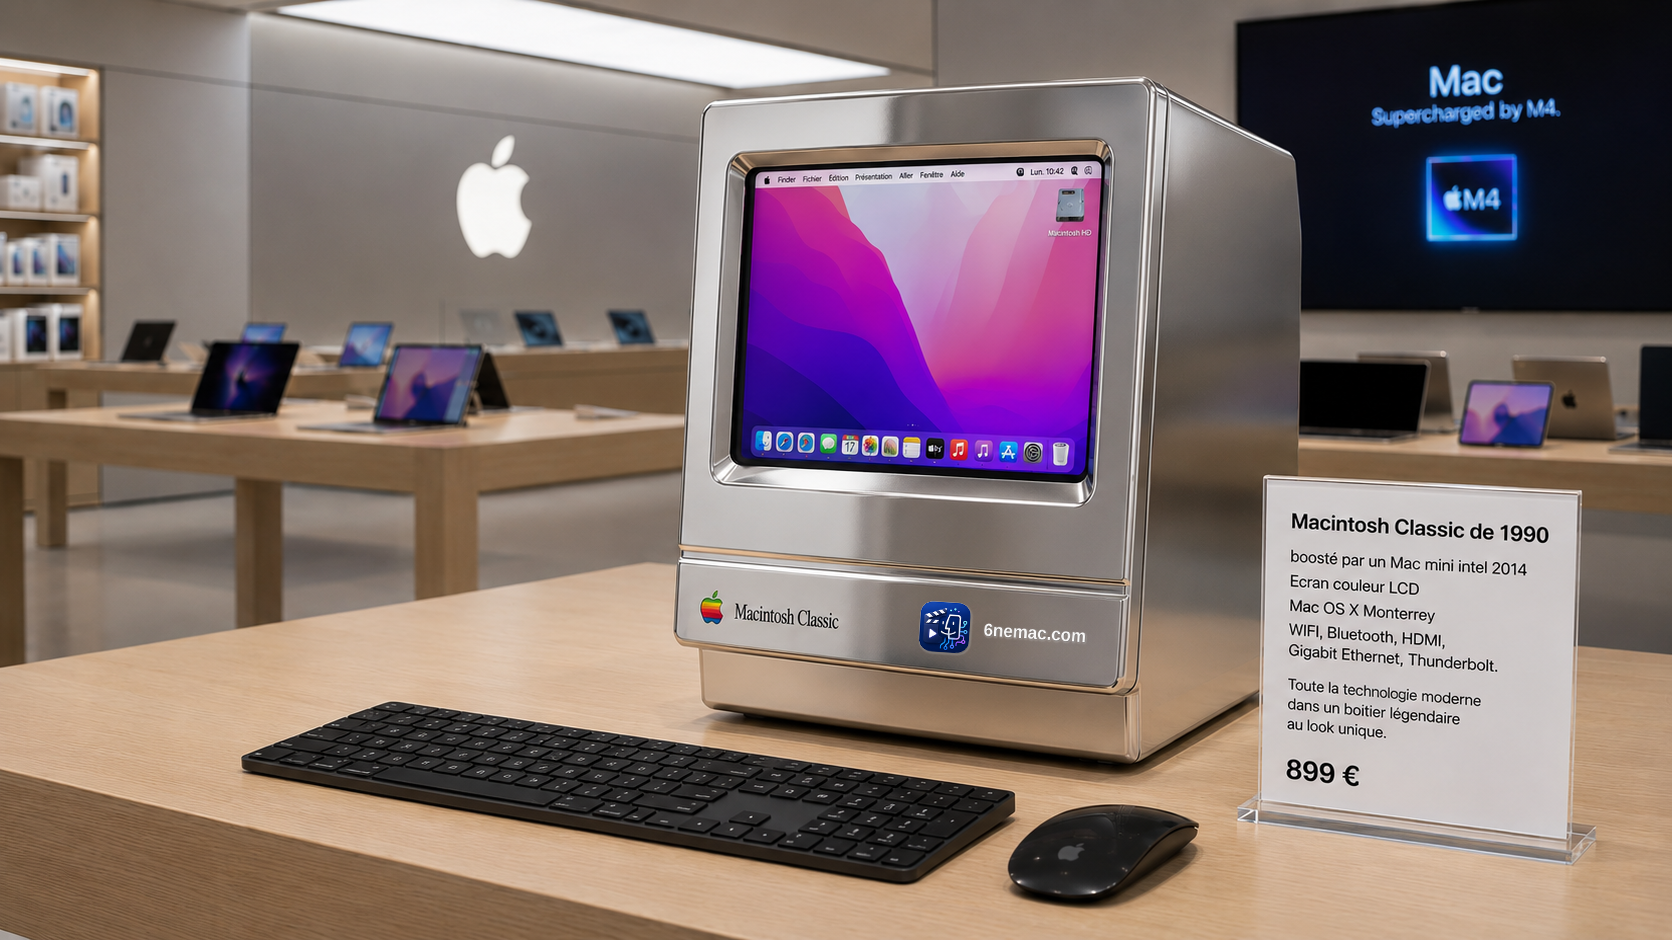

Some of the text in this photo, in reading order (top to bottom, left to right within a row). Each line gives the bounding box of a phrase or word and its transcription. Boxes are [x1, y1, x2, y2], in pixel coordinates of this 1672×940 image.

[1429, 64, 1504, 98] Mac
[1371, 98, 1561, 129] Supercharged by M4.
[802, 175, 822, 183] Fichier
[1046, 167, 1064, 175] 10:42
[1463, 187, 1502, 211] M4
[845, 441, 855, 452] 17
[1291, 512, 1550, 544] Macintosh Classic de 1990
[1290, 550, 1527, 576] boosté par un Mac mini intel 2014
[1290, 575, 1420, 596] Ecran couleur LCD
[734, 603, 839, 630] Macintosh Classic
[1289, 599, 1436, 625] Mac OS X Monterrey
[983, 622, 1087, 644] 6nemac.com
[1289, 623, 1446, 650] WIFI, Bluetooth, HDMI,
[1288, 643, 1499, 673] Gigabit Ethernet, Thunderbolt.
[1288, 678, 1482, 707] Toute la technologie moderne
[1287, 698, 1461, 726] dans un boitier légendaire
[1287, 718, 1387, 740] au look unique.
[1286, 759, 1360, 786] 899 €
